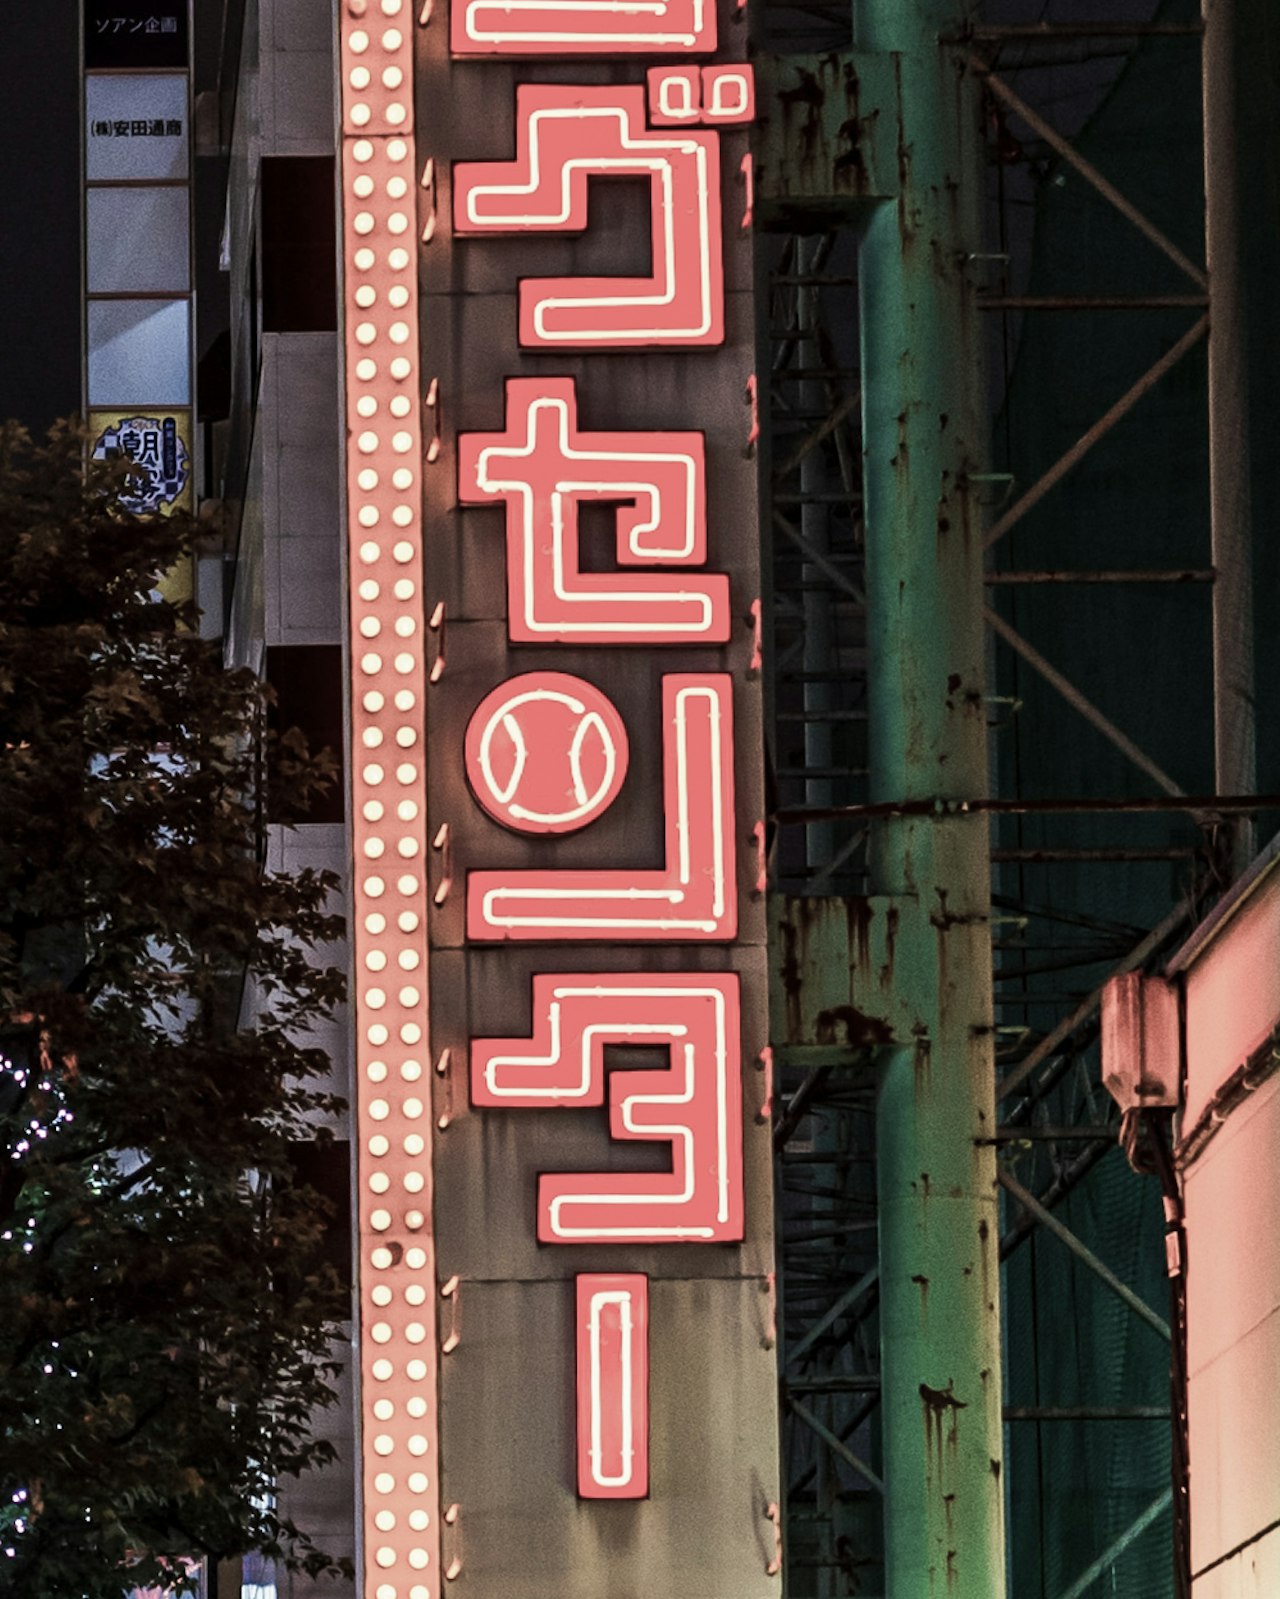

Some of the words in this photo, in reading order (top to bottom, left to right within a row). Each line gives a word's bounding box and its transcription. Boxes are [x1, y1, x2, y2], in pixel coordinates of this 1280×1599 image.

[96, 16, 178, 35] ソアン企画
